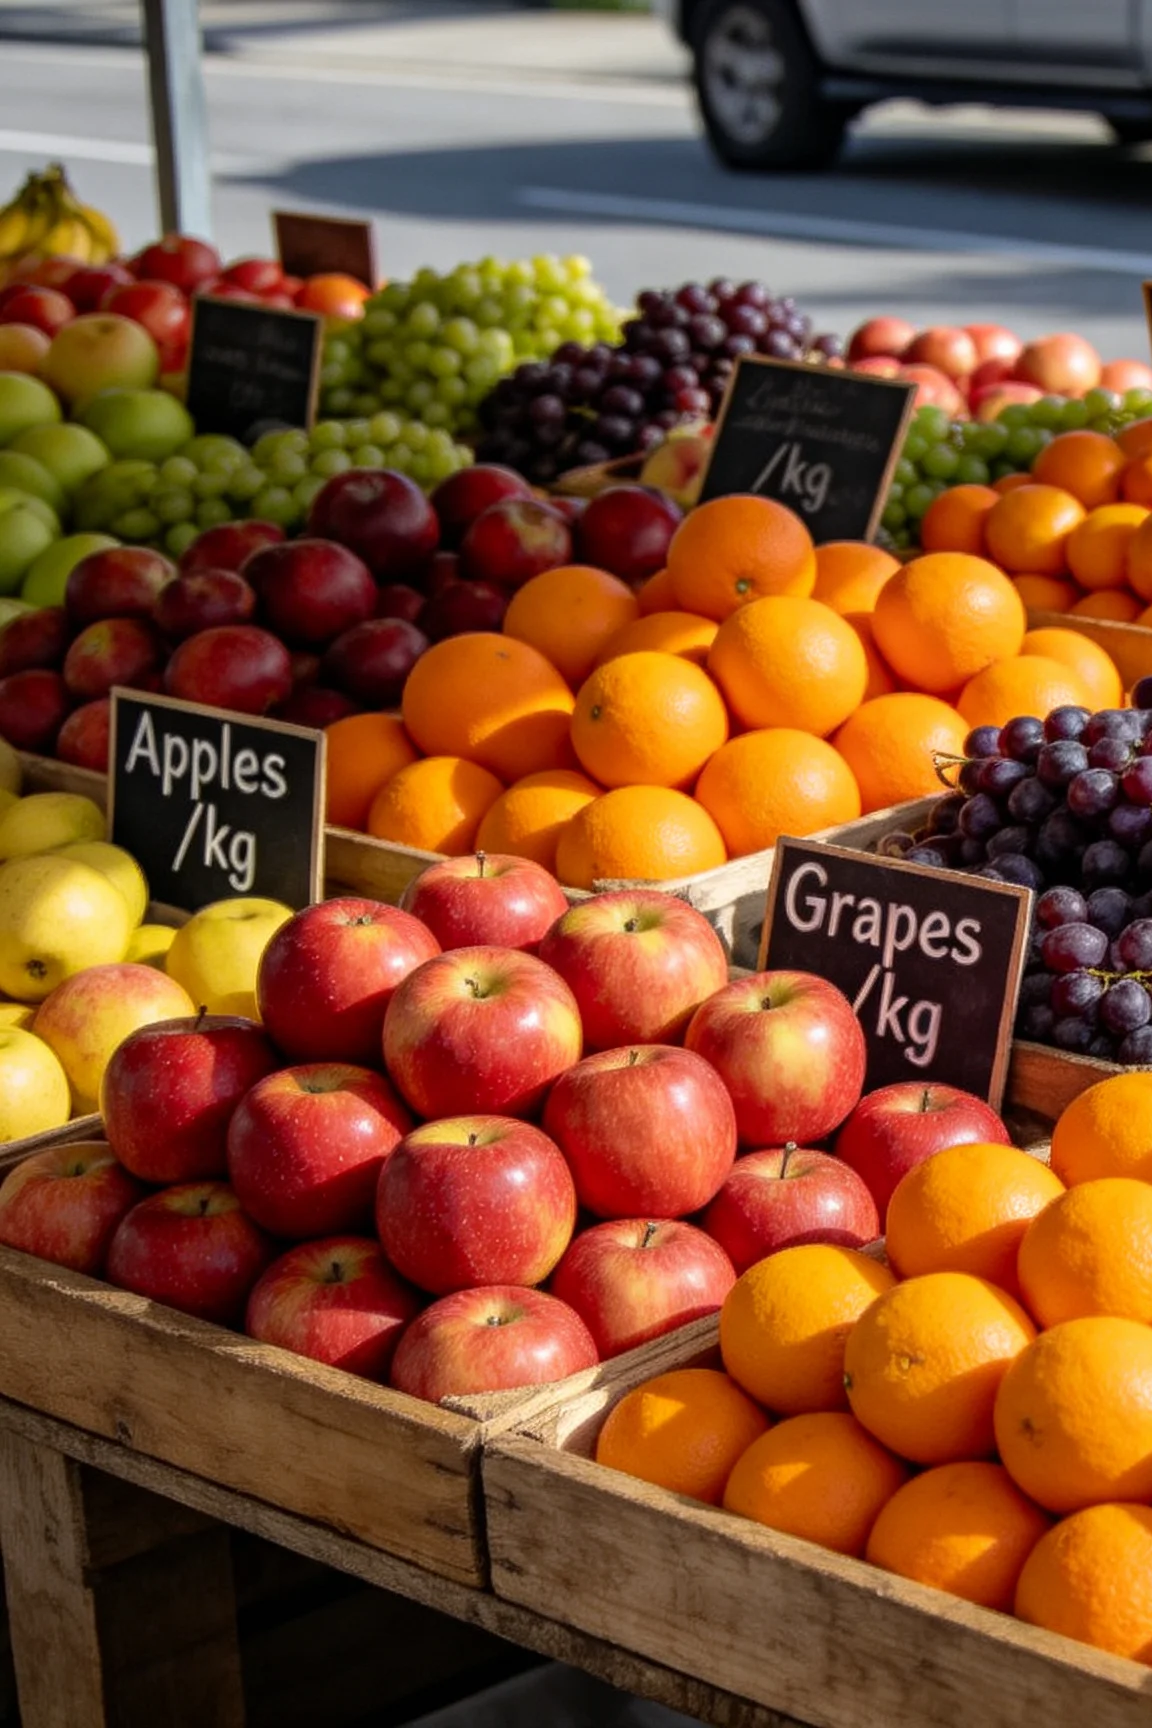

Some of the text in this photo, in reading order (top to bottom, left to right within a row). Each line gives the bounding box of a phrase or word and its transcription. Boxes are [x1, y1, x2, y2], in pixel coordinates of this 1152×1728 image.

[752, 442, 831, 513] /kg
[124, 710, 288, 800] Apples
[171, 802, 256, 893] /kg
[785, 861, 983, 968] Grapes
[853, 964, 942, 1068] /kg
